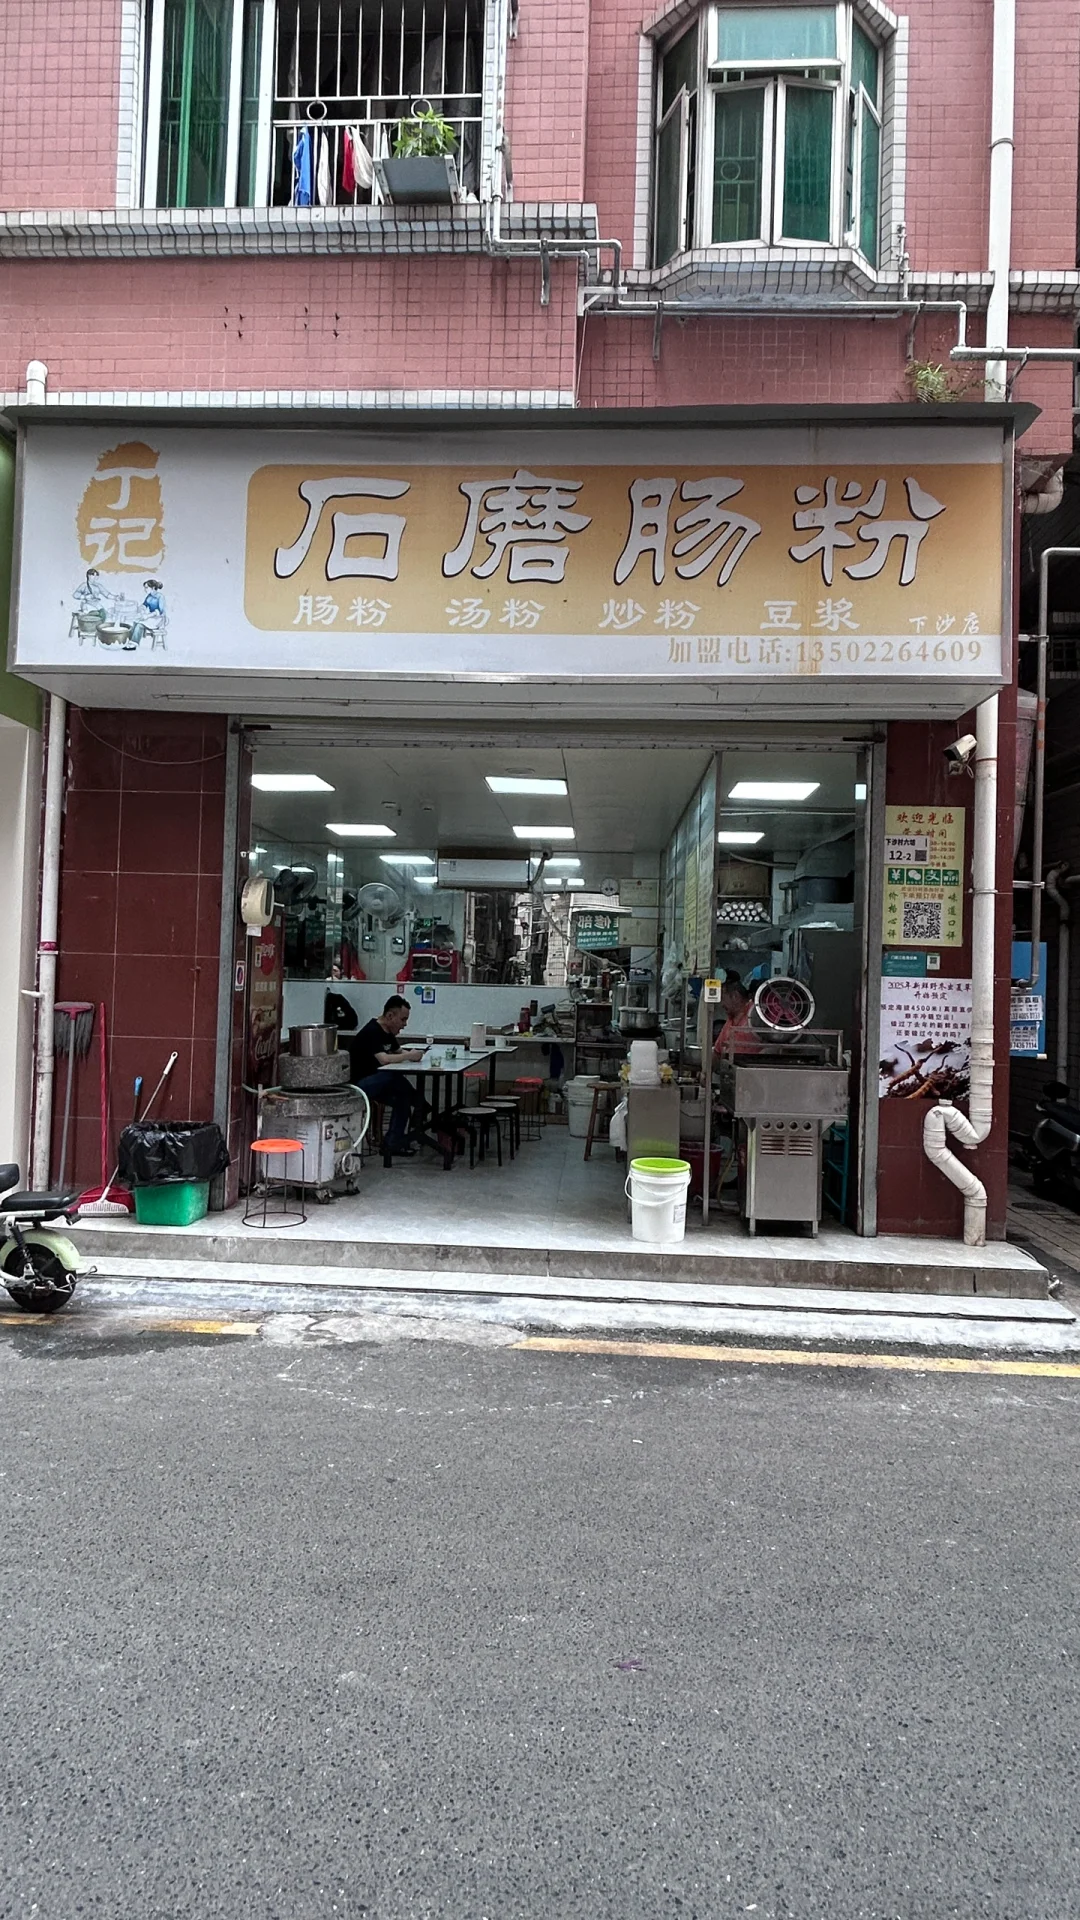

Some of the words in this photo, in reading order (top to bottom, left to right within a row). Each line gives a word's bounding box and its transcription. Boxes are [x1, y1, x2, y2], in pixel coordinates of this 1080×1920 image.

[85, 467, 162, 566] 丁记
[273, 469, 946, 587] 石磨肠粉
[293, 595, 391, 627] 肠粉
[445, 597, 545, 629] 汤粉
[598, 598, 702, 630] 炒粉
[759, 599, 860, 631] 豆浆
[909, 612, 980, 634] 下沙店
[667, 636, 982, 665] 加盟电话:13502264609
[897, 812, 954, 825] 欢迎光临
[889, 850, 912, 861] 12-2
[914, 991, 948, 1000] 开始预定
